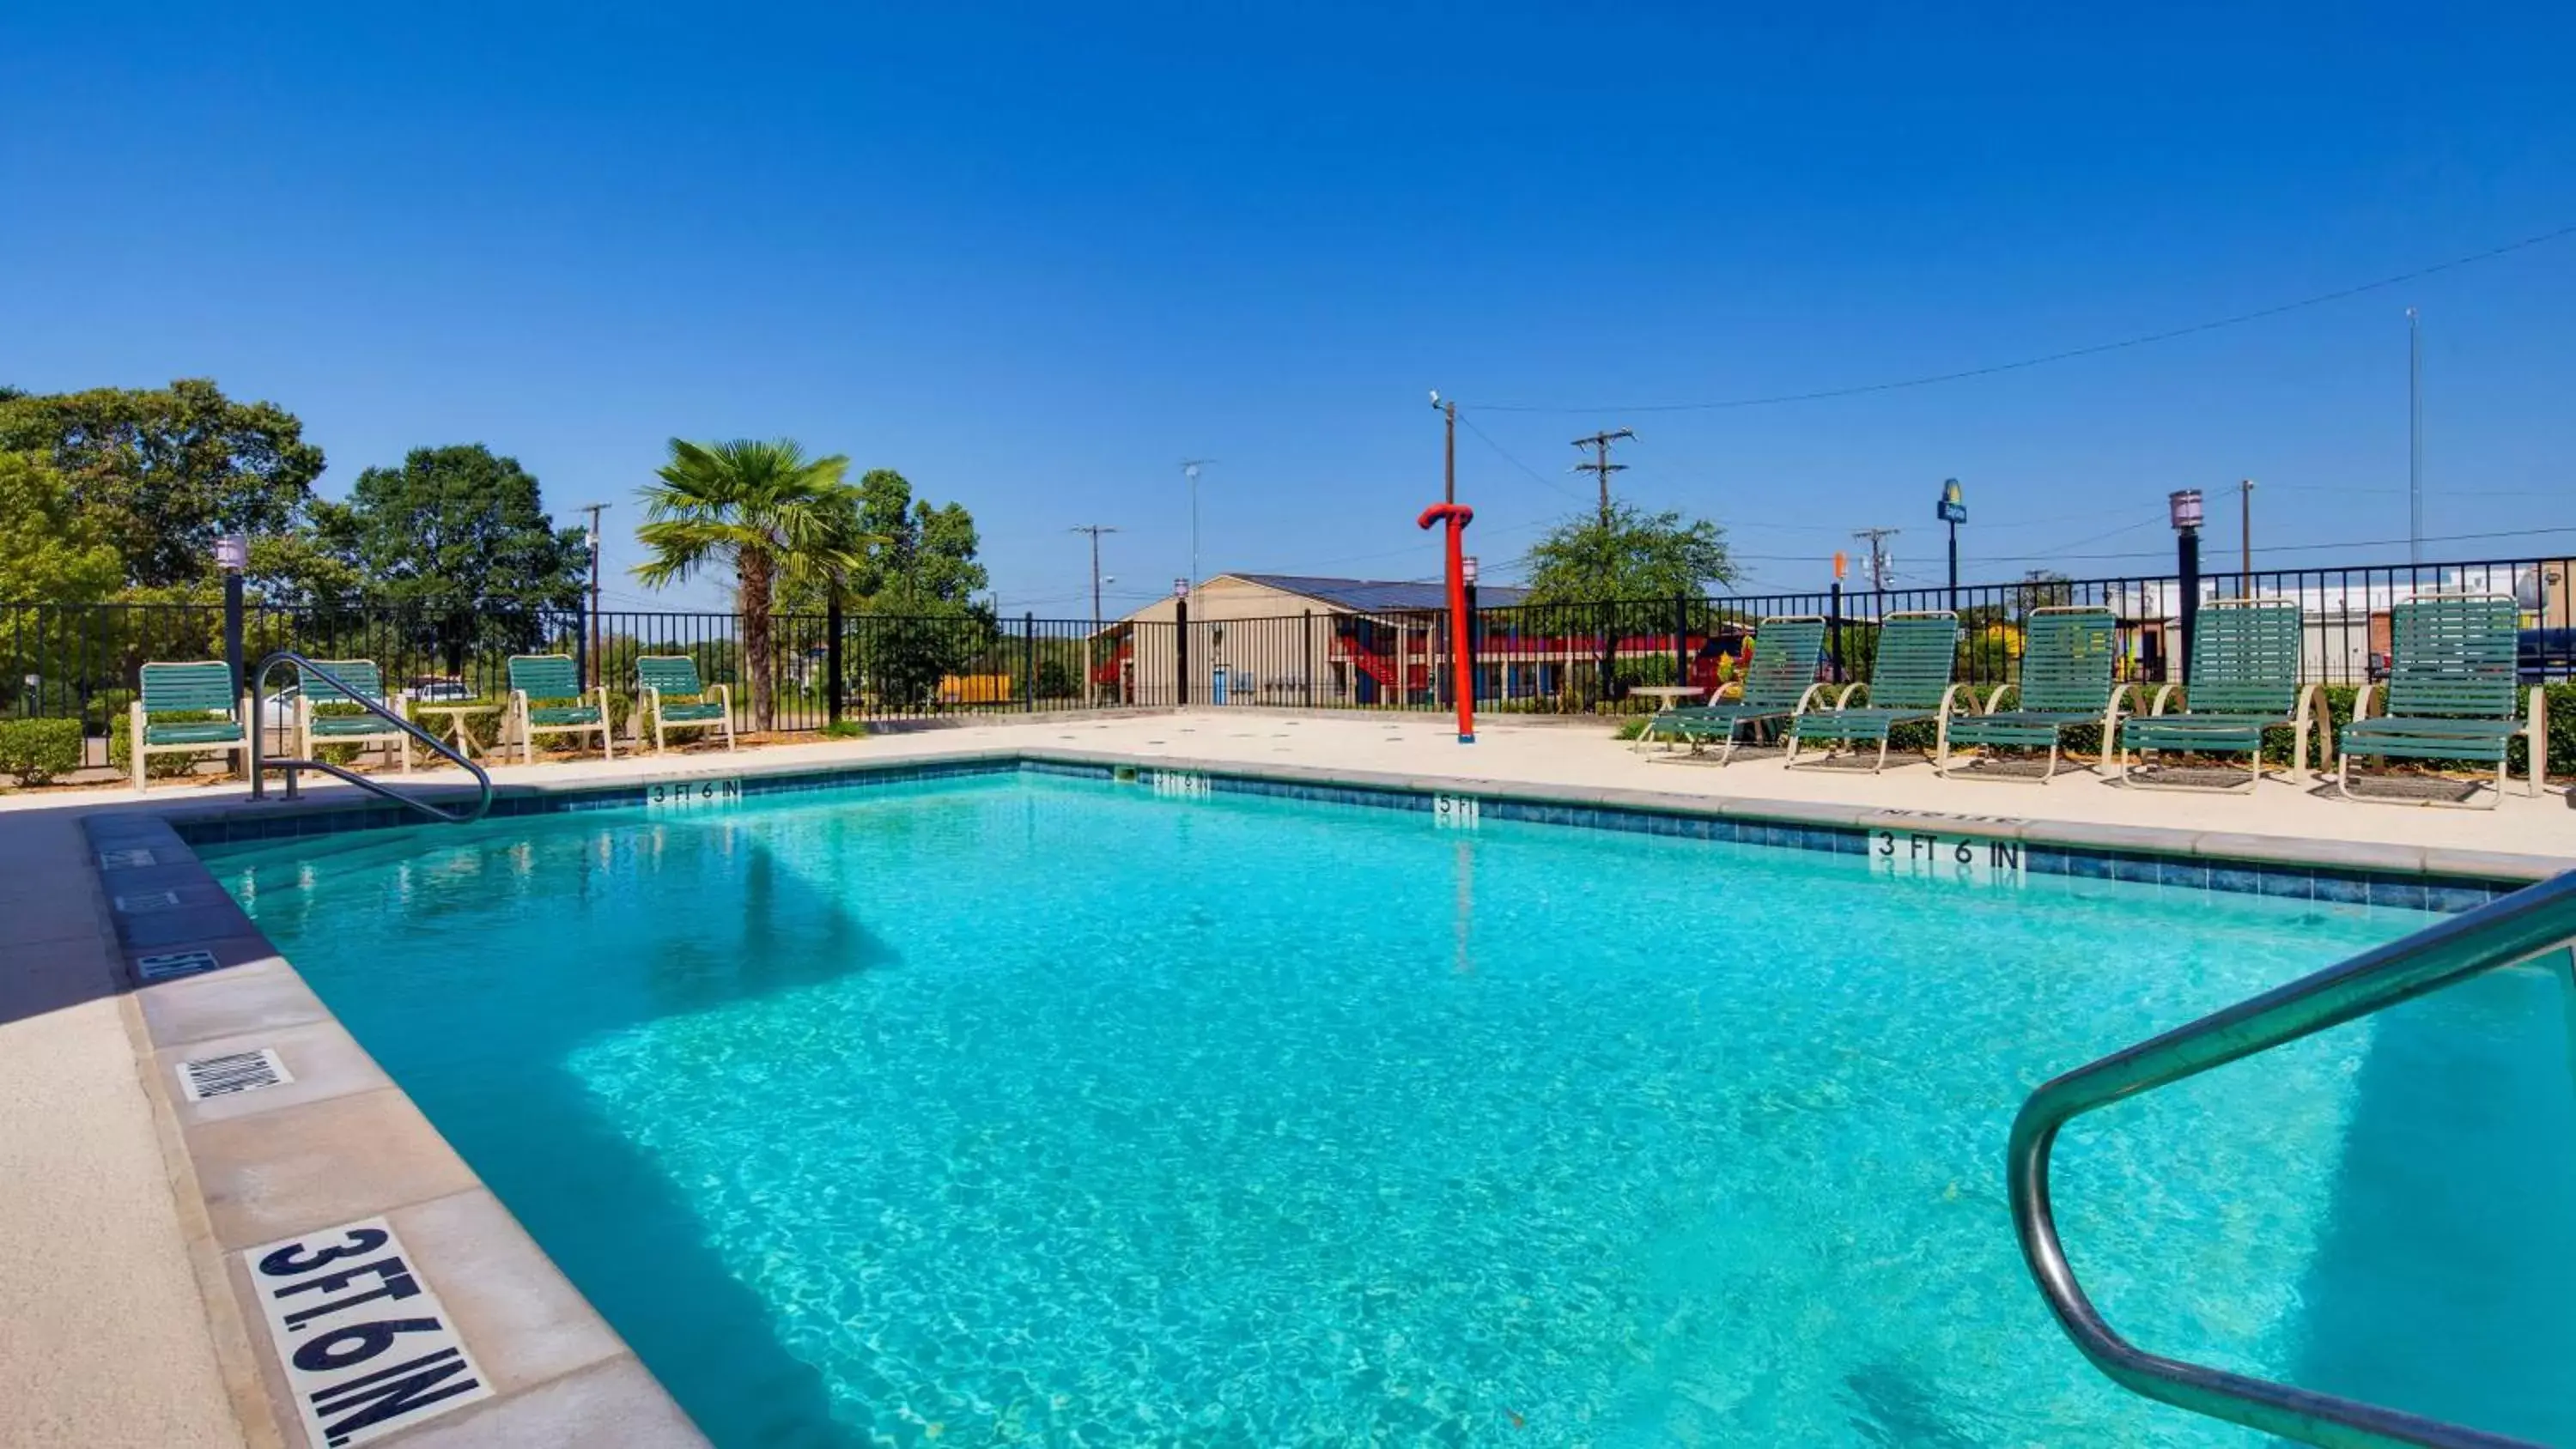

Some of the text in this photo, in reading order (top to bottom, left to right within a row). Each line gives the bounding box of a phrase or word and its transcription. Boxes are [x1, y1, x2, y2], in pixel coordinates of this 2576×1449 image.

[653, 780, 738, 803] 3 FT 6 IN
[1440, 794, 1474, 815] 5 FT
[1879, 831, 2019, 869] 3 FT 6 IN
[258, 1228, 389, 1276] 3
[292, 1317, 443, 1372] 6
